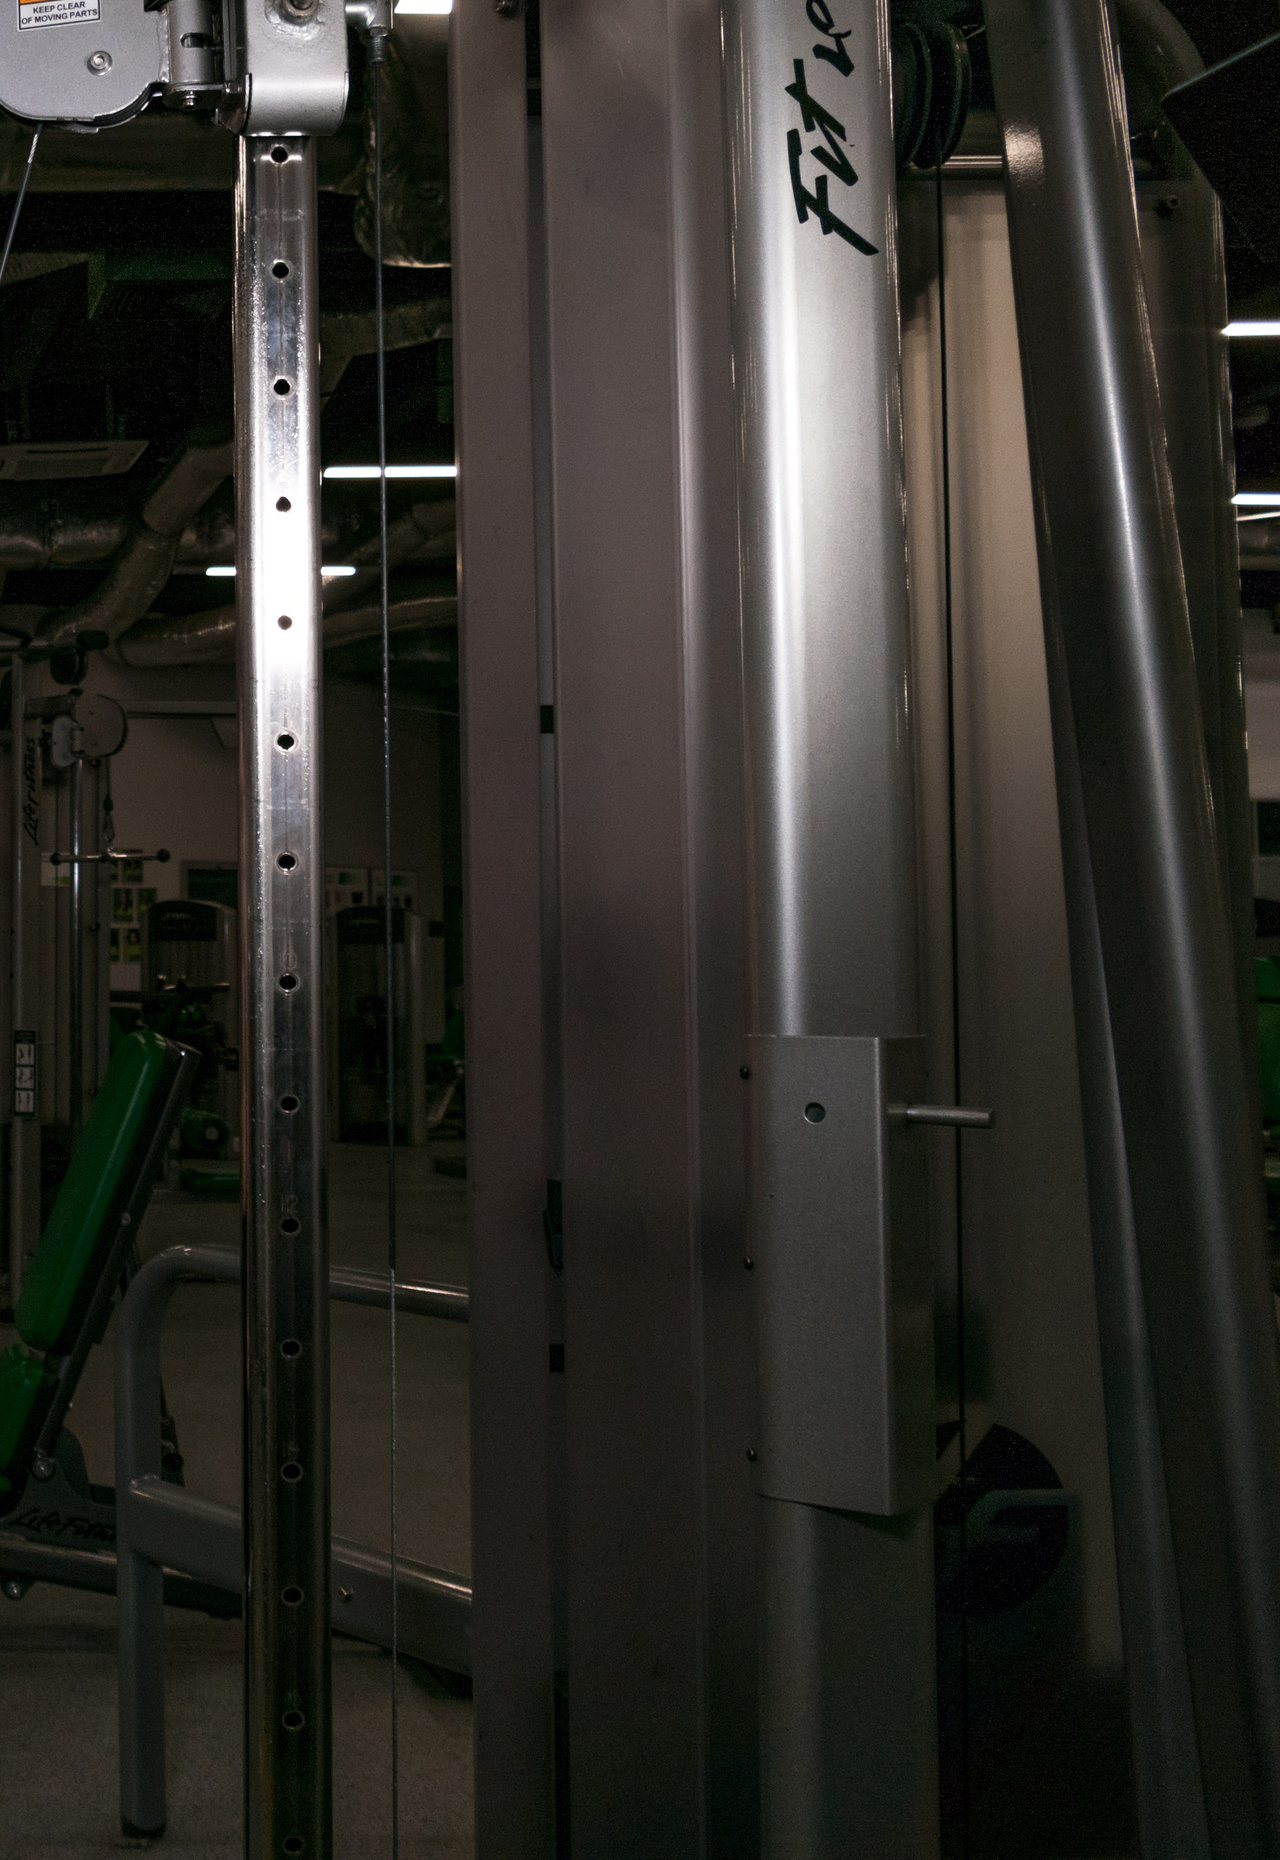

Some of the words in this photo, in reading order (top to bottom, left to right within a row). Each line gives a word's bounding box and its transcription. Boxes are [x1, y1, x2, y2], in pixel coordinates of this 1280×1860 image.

[33, 5, 55, 14] KEEP
[57, 1, 85, 11] CLEAR
[22, 17, 33, 25] OF
[35, 12, 68, 23] MOVING
[70, 8, 98, 18] PARTS
